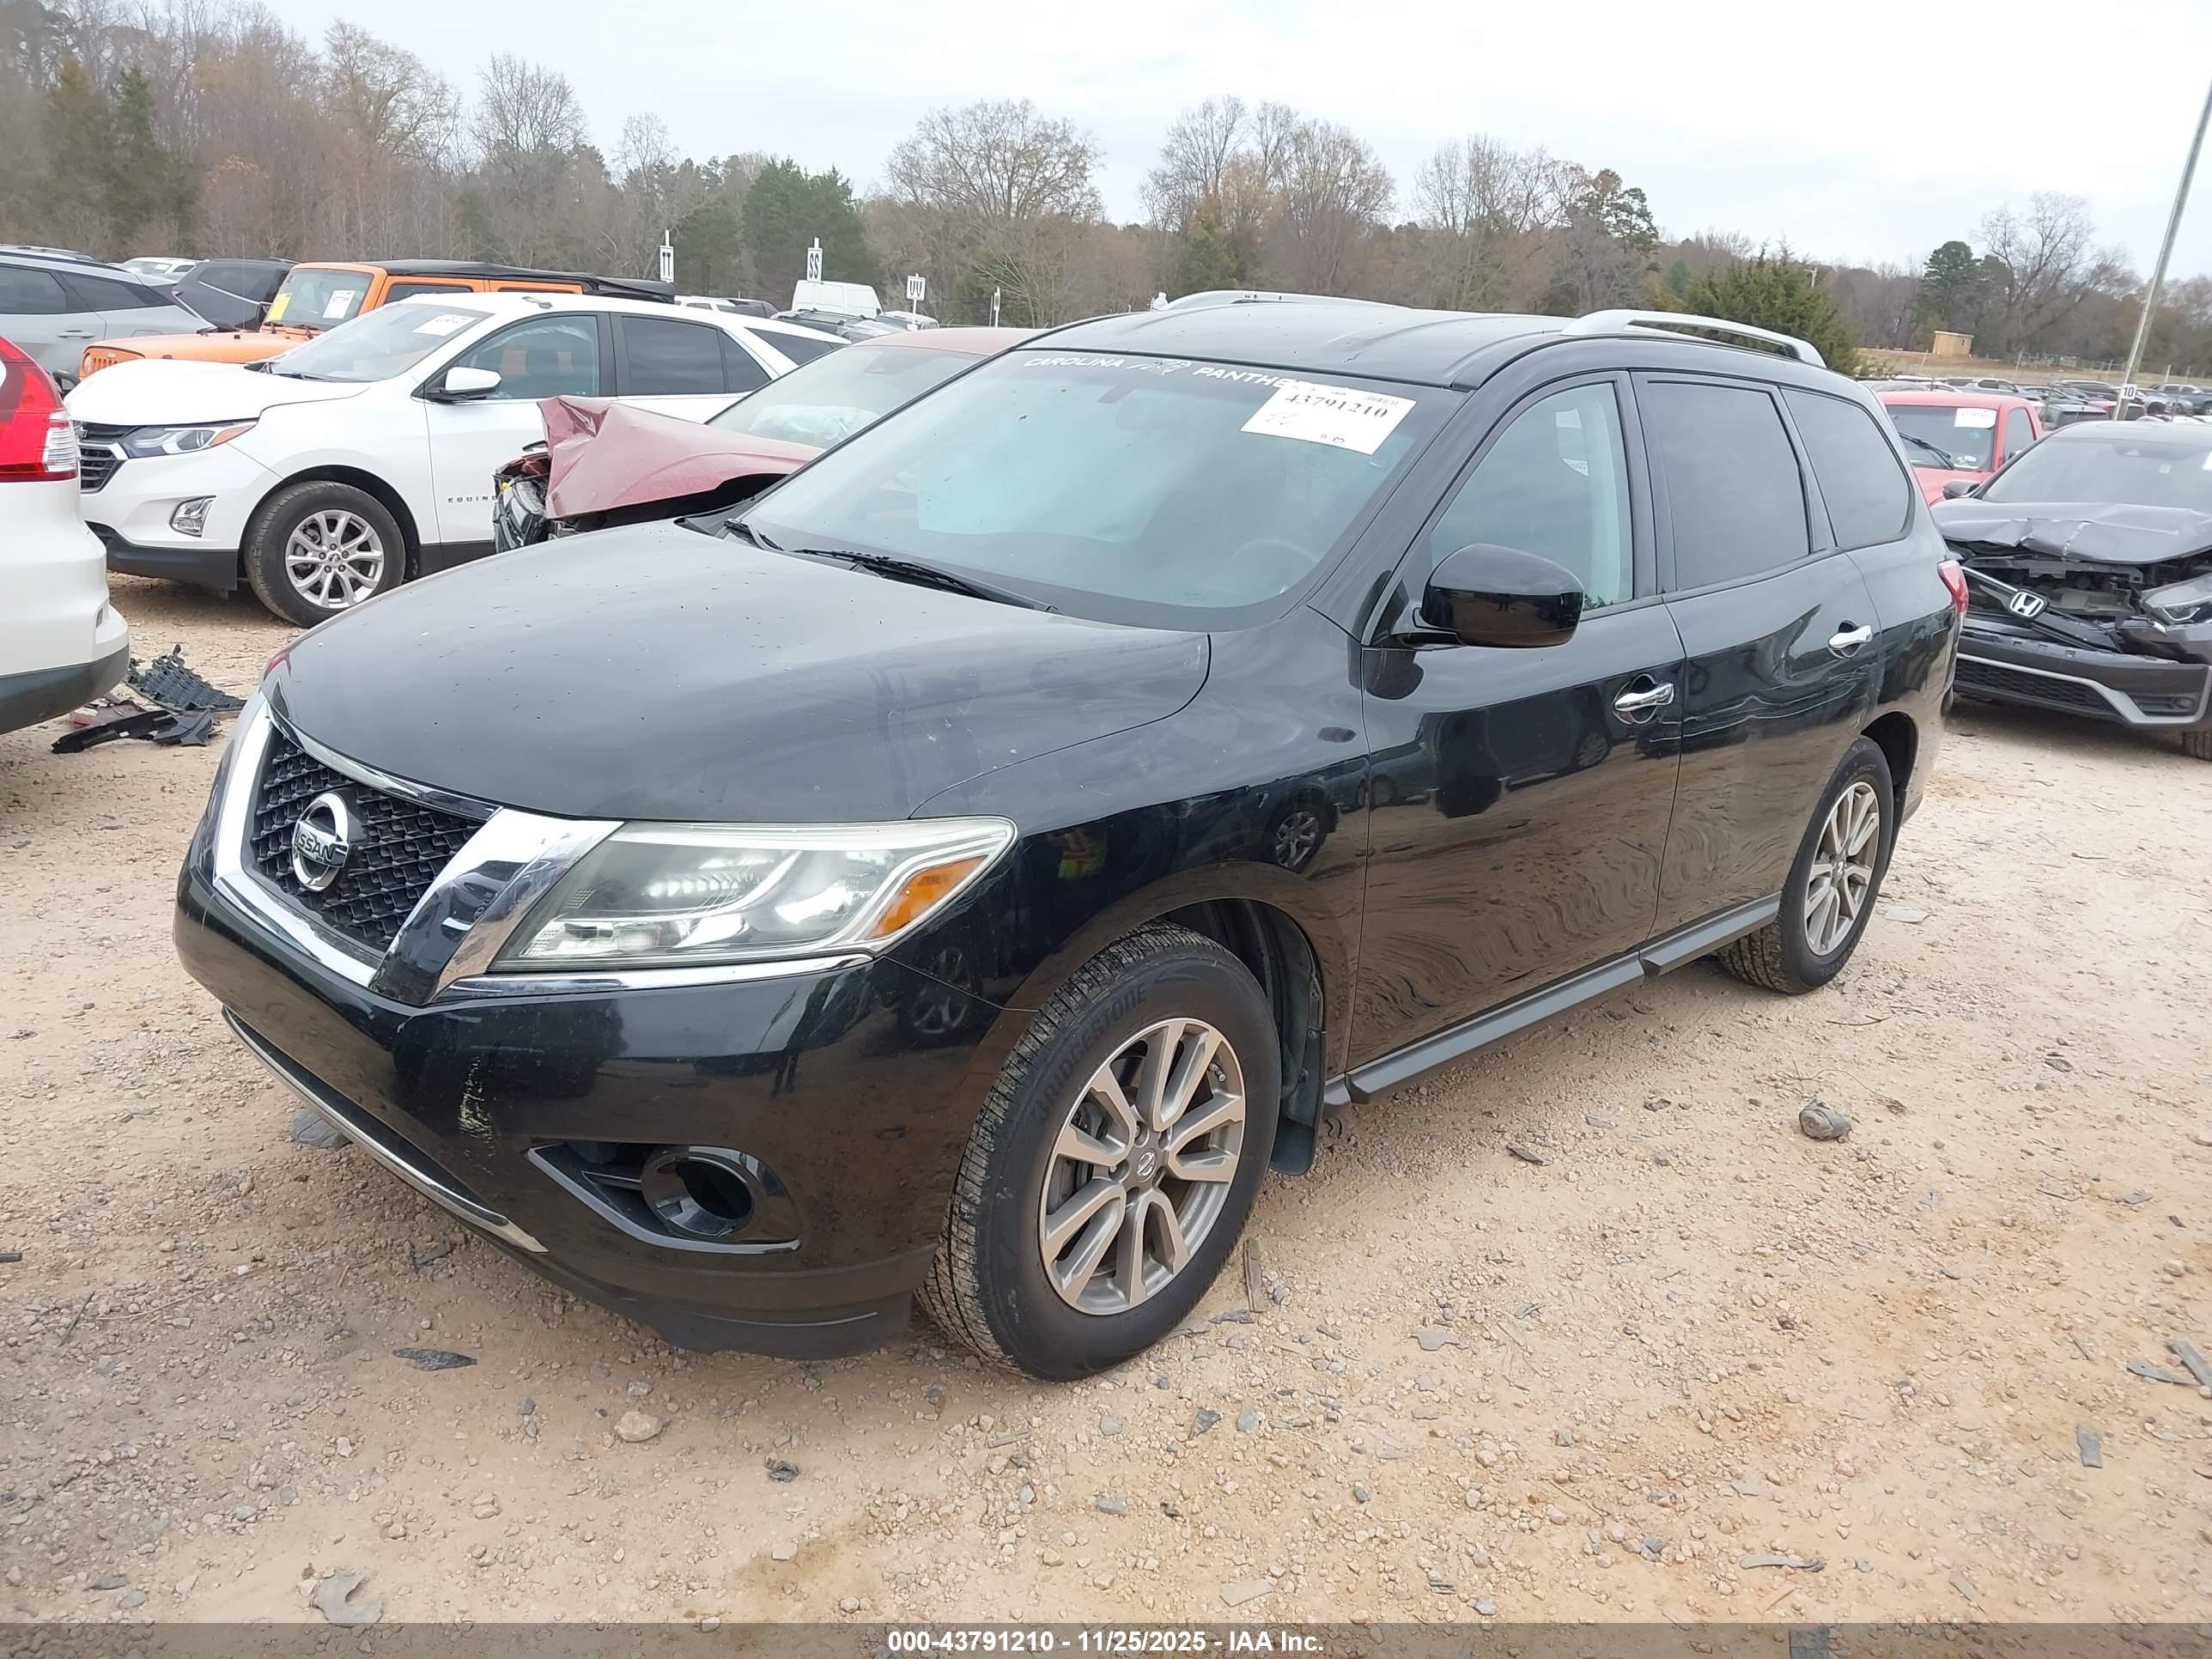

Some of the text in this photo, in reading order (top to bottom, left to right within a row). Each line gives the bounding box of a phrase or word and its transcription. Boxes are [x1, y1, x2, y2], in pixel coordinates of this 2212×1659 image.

[809, 252, 819, 280] SS
[1023, 357, 1297, 388] CAROLINA PANTHE
[2124, 386, 2135, 398] 10
[1285, 393, 1389, 418] 43791210
